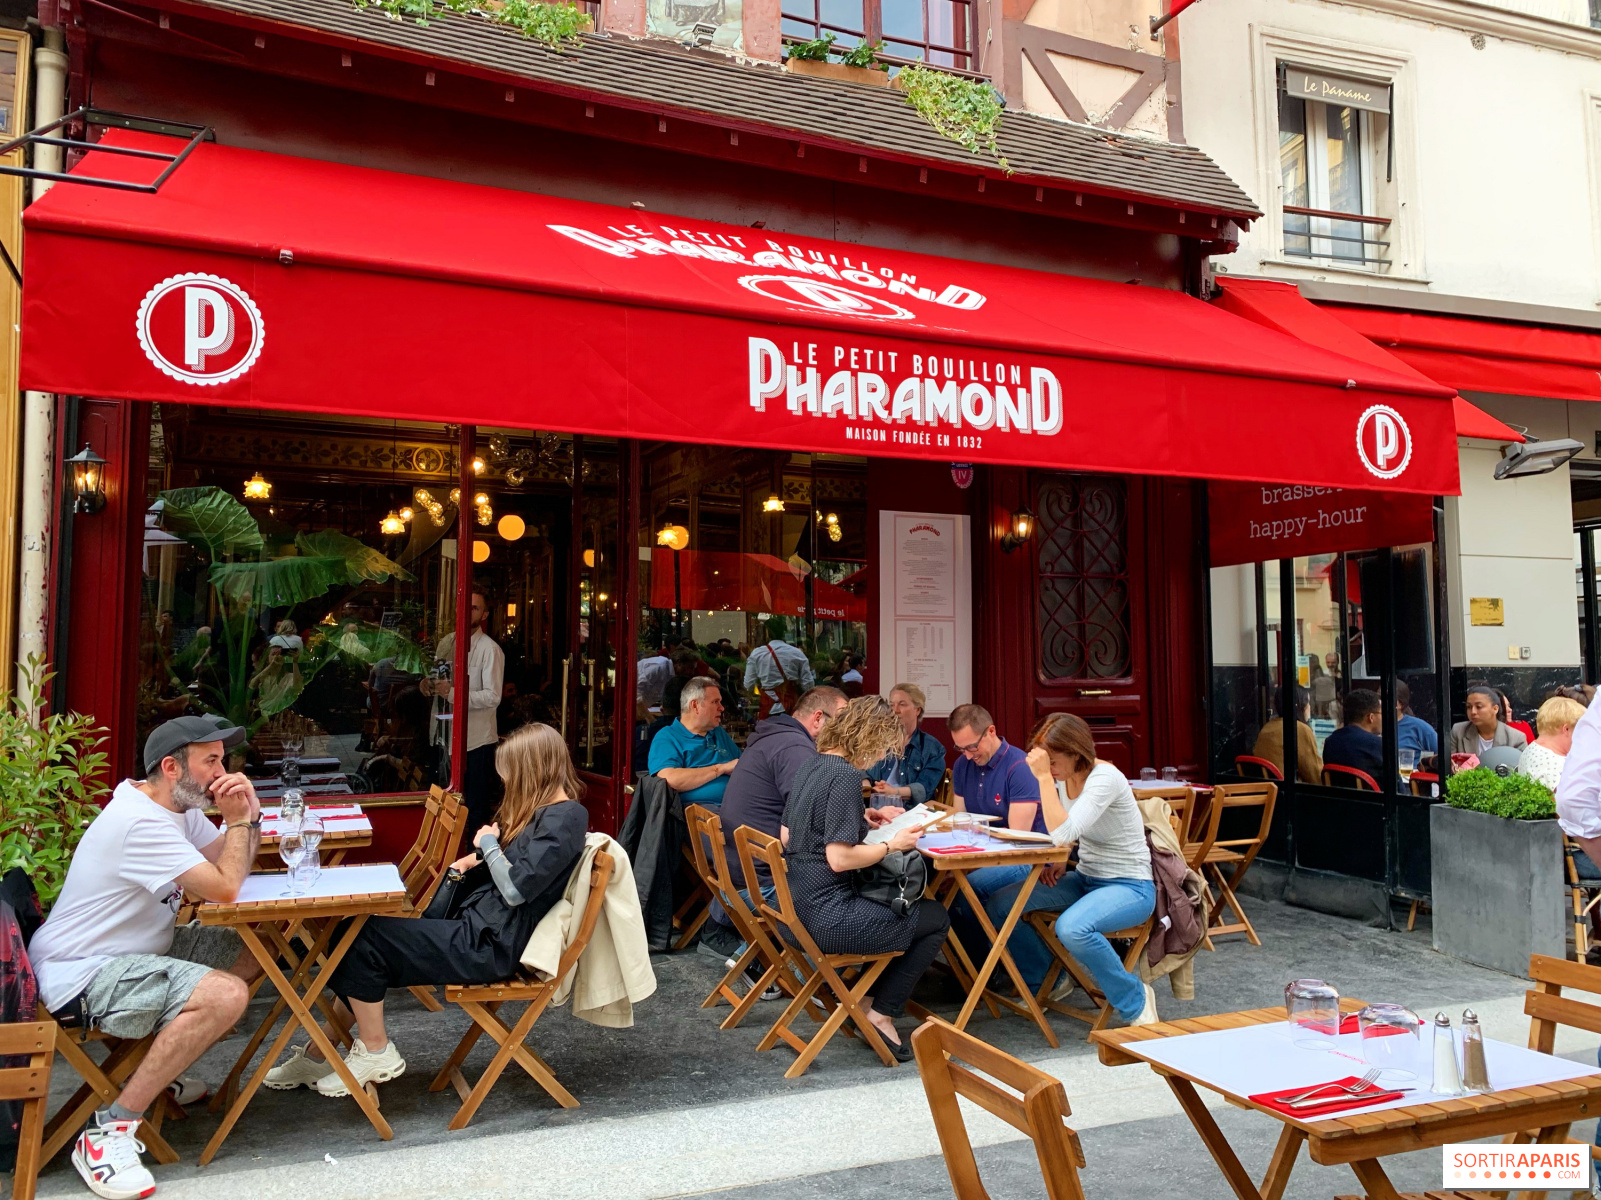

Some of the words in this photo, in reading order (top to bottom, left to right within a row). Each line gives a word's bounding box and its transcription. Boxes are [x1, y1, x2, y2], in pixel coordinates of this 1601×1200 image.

[1304, 76, 1317, 92] Le
[1322, 81, 1371, 102] Paname
[545, 224, 987, 311] PHARAMOND
[608, 224, 653, 237] LE
[660, 226, 746, 248] PETIT
[766, 239, 917, 285] BOUILLON
[184, 286, 235, 371] P
[748, 336, 1063, 436] PHARAMOND
[793, 341, 818, 365] LE
[834, 346, 898, 372] PETIT
[913, 354, 1021, 385] BOUILLON
[846, 427, 886, 441] MAISON
[893, 430, 931, 445] FONDÉE
[937, 434, 950, 447] EN
[957, 435, 982, 449] 1832
[1375, 413, 1399, 470] P
[958, 470, 967, 480] IV
[1250, 506, 1367, 540] happy-hour
